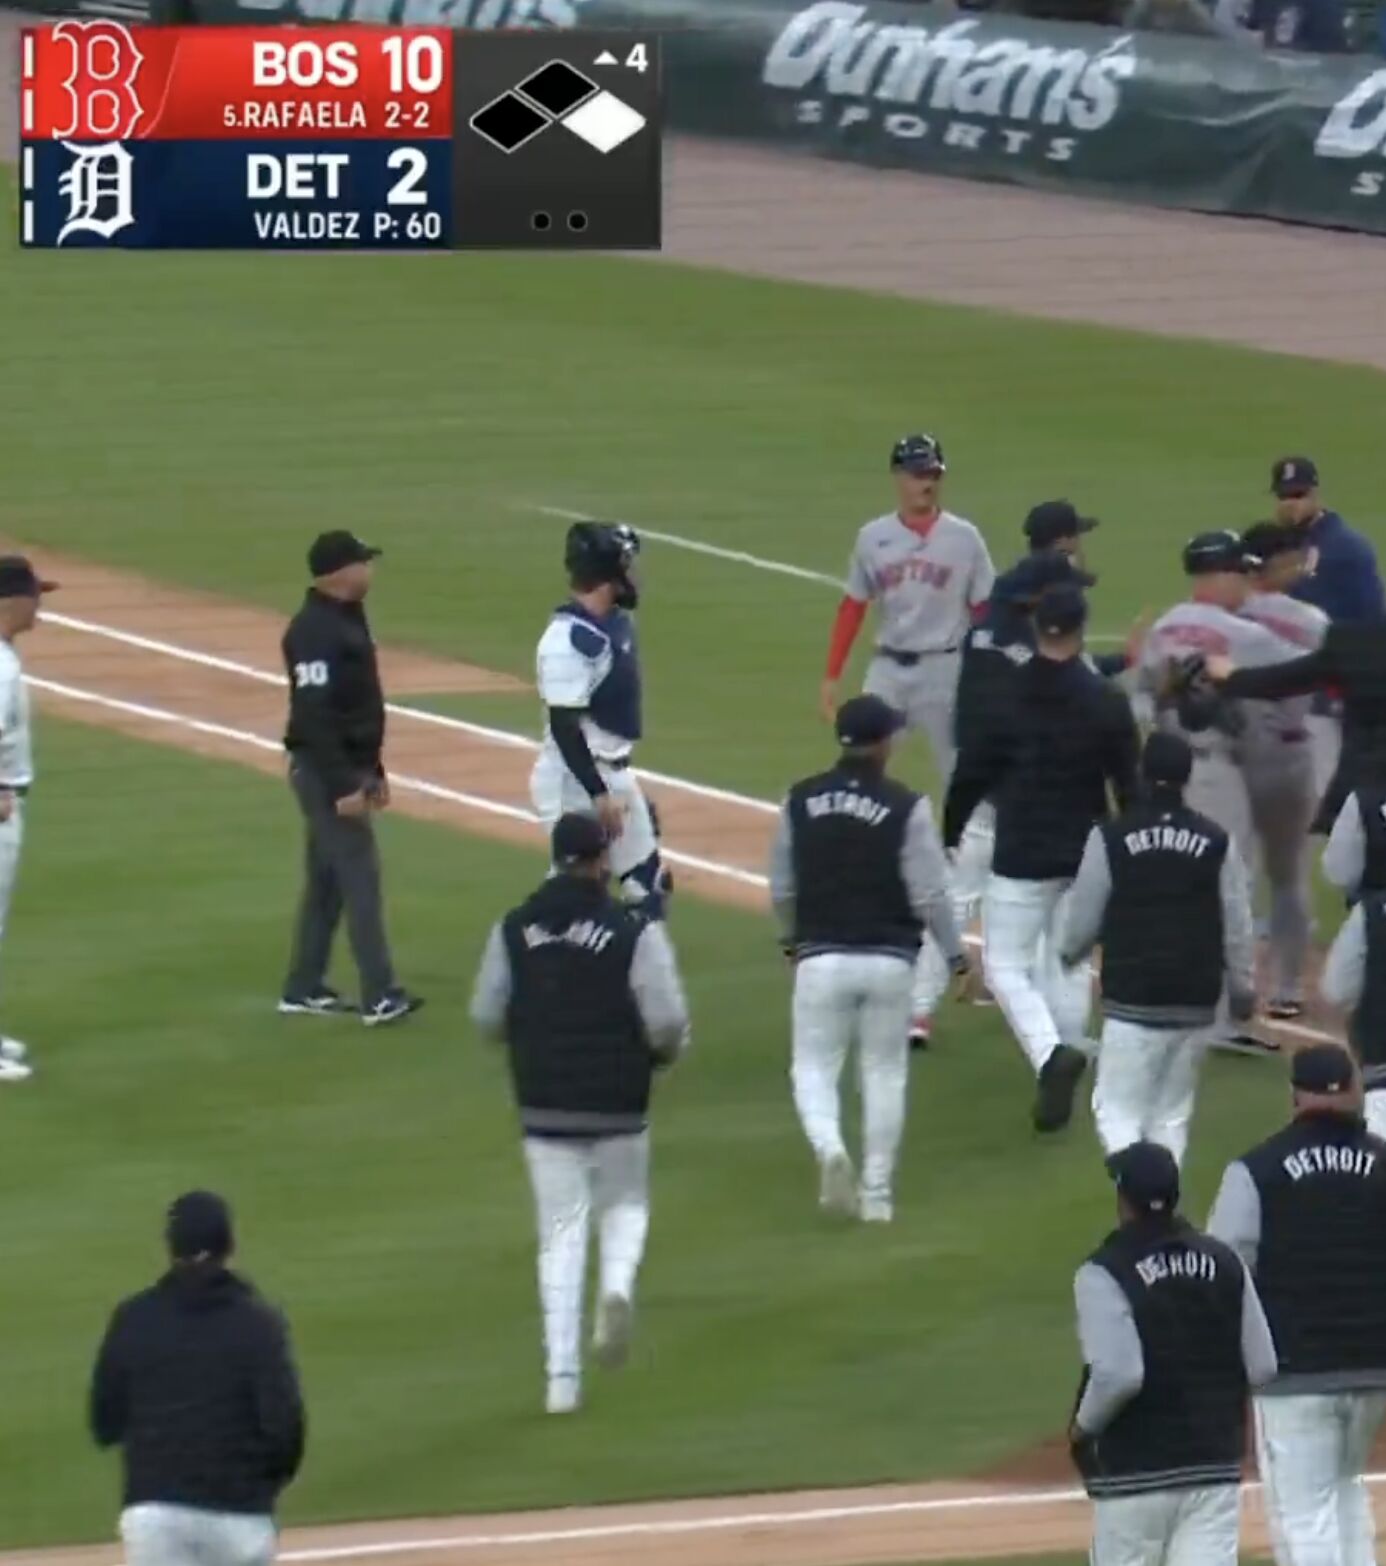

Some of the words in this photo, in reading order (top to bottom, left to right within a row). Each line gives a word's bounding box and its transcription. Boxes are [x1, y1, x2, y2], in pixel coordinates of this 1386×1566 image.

[763, 0, 1136, 131] Dunham's
[795, 100, 1078, 161] SPORTS
[1124, 826, 1211, 858] DETROIT
[1283, 1144, 1376, 1181] DETROIT
